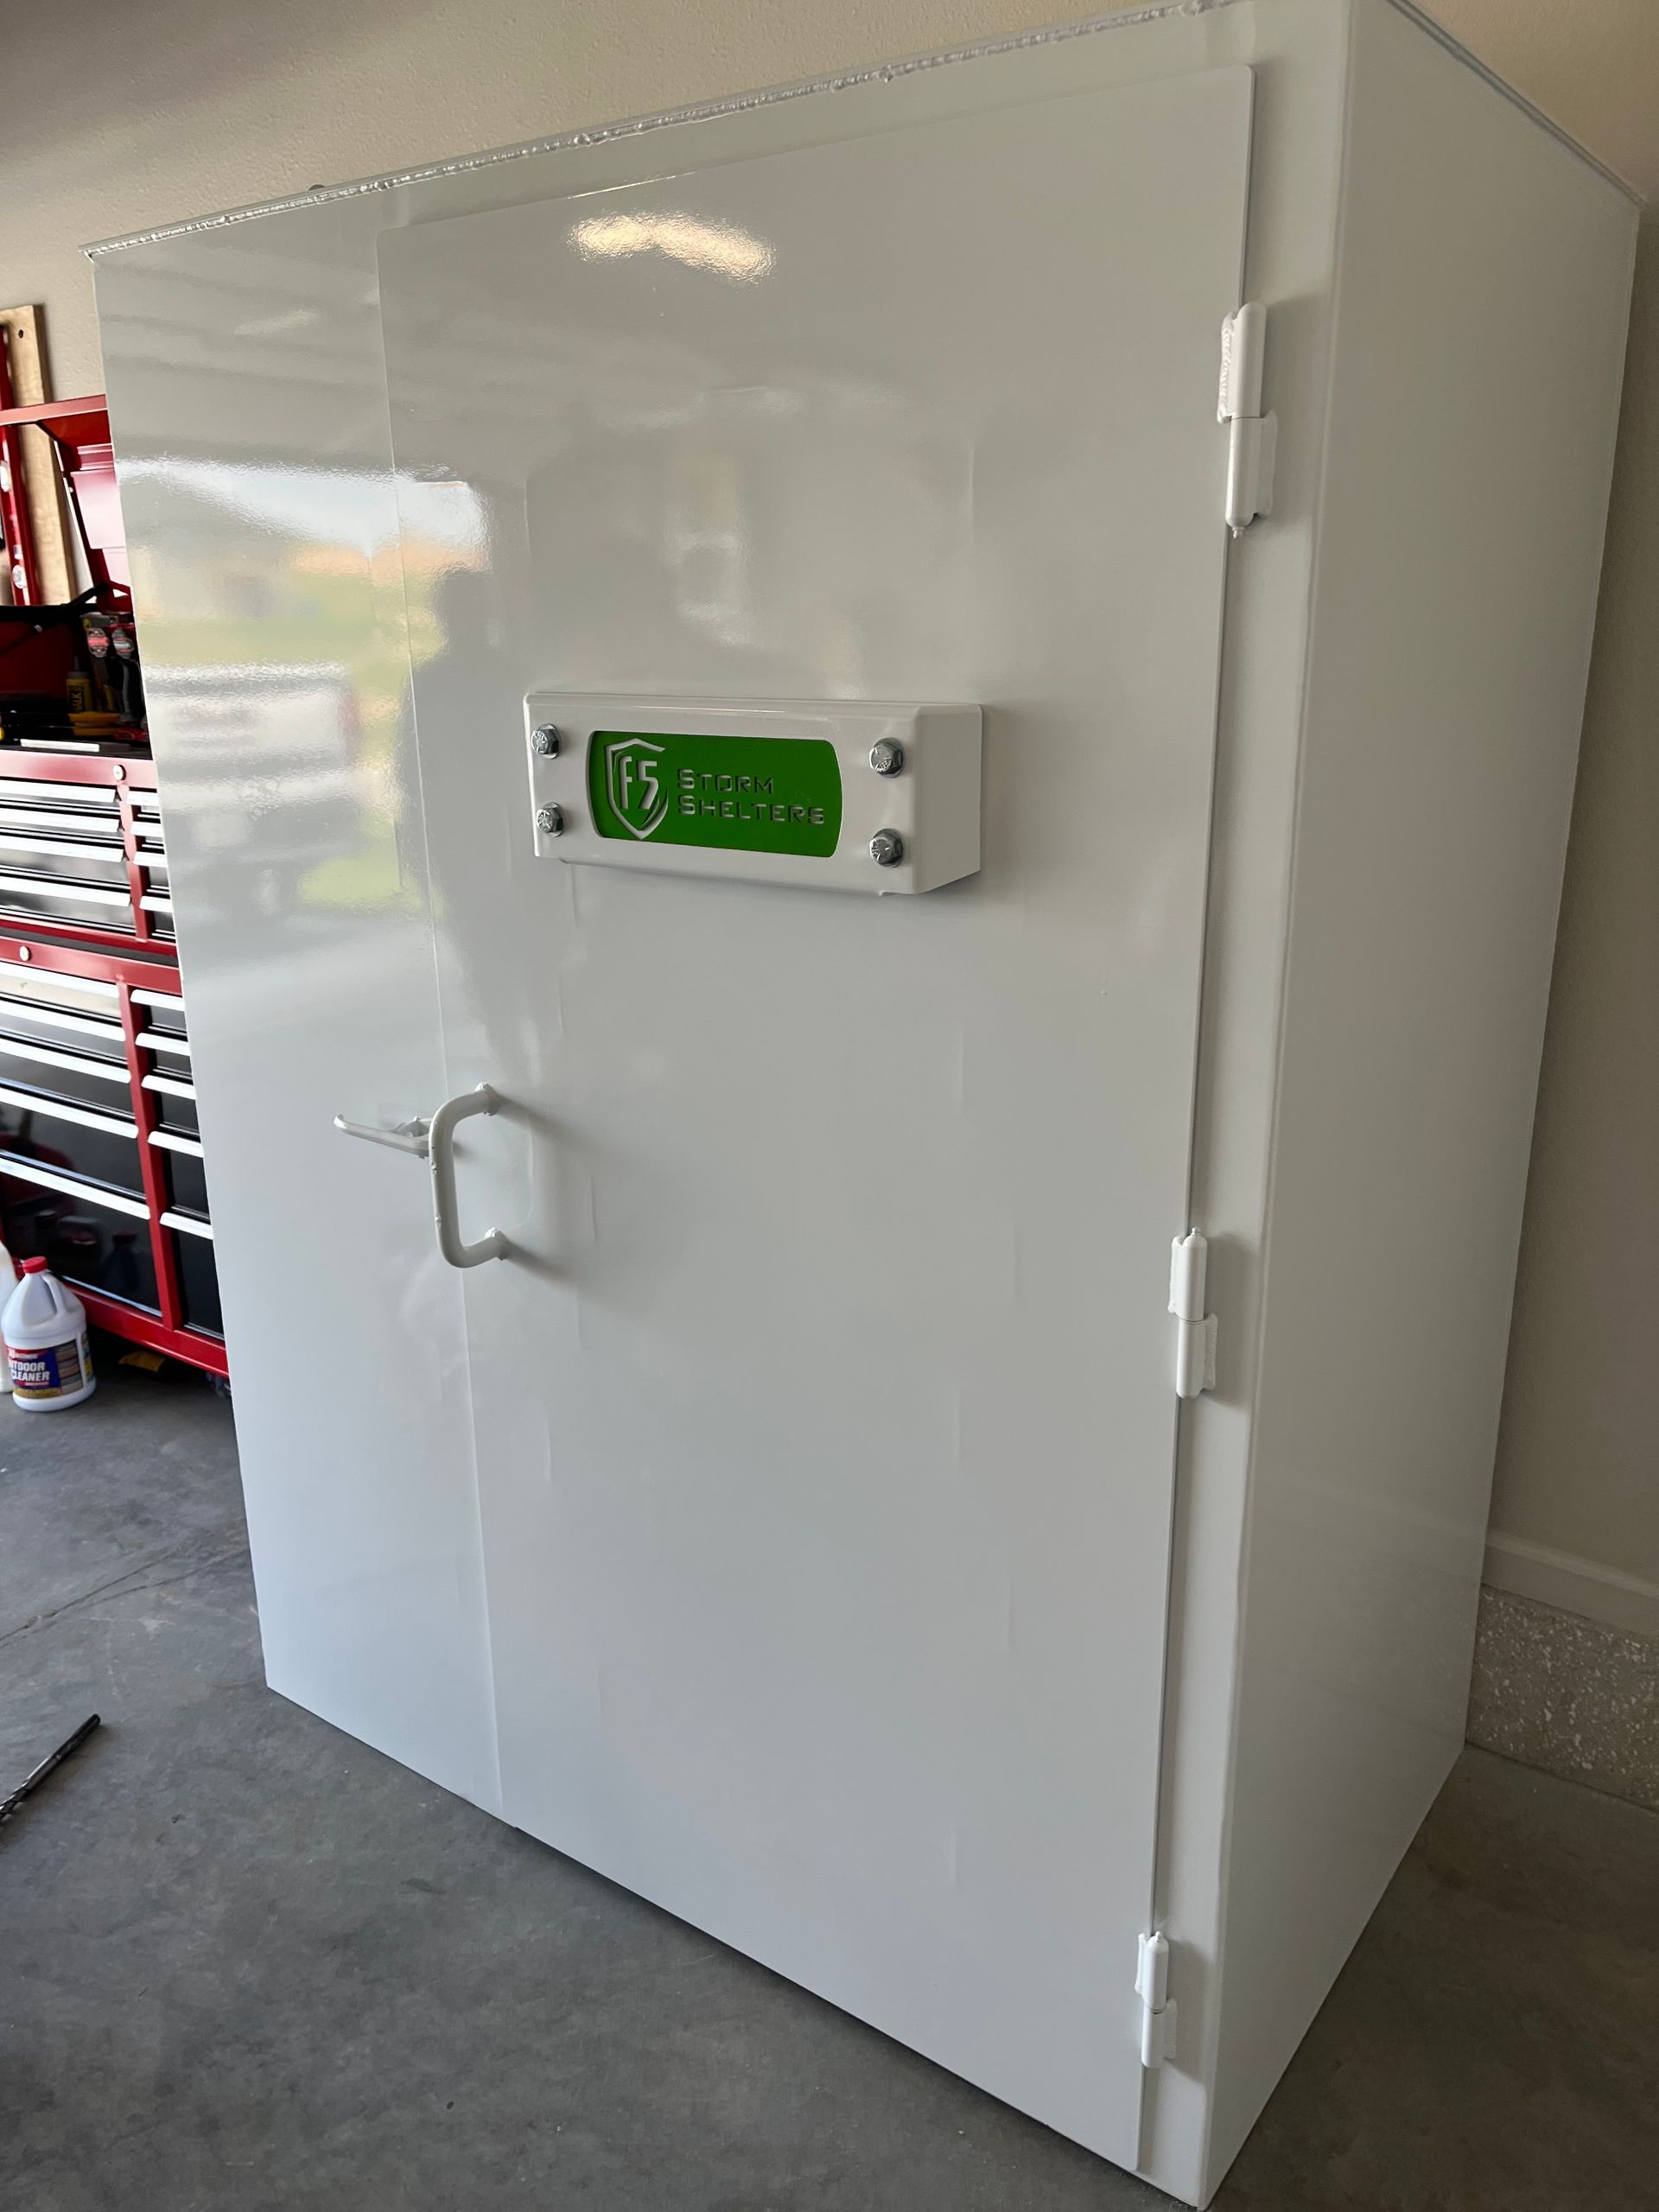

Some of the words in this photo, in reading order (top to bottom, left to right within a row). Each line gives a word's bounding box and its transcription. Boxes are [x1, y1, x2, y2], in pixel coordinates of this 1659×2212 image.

[620, 756, 659, 810] F5
[678, 769, 774, 794] STORM
[678, 795, 825, 824] SHELTERS
